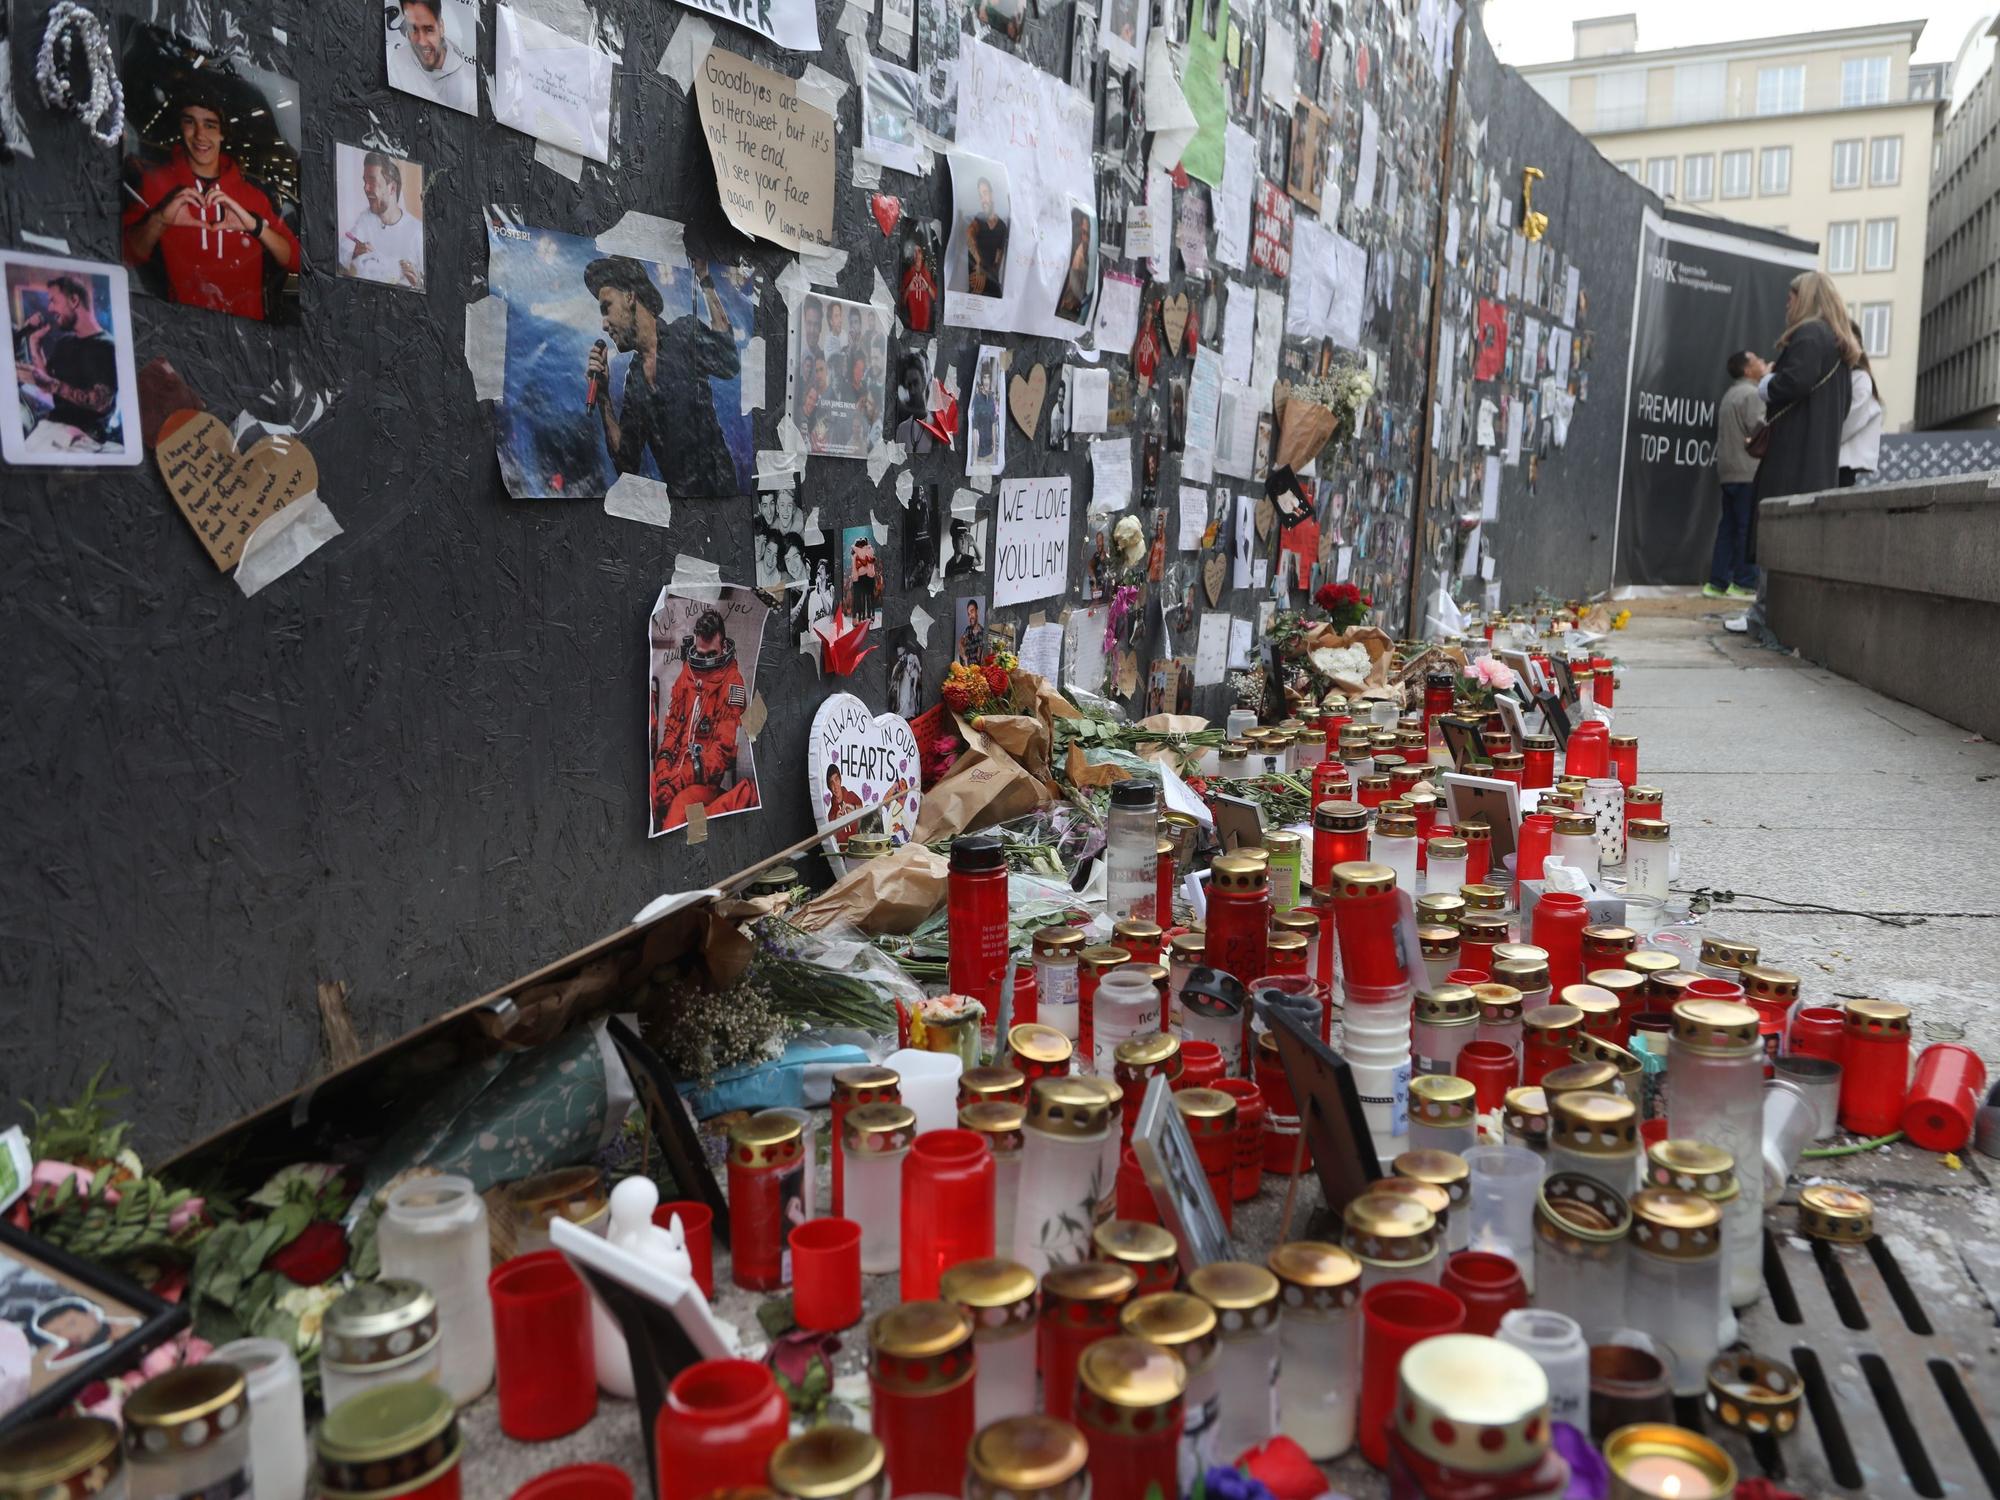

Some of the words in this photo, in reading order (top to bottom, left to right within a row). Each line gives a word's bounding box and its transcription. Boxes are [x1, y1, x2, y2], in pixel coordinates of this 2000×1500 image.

[706, 54, 772, 106] Goodbyes
[779, 92, 798, 113] are
[708, 123, 728, 145] not
[736, 130, 757, 158] the
[786, 117, 806, 142] but
[732, 164, 749, 184] see
[755, 171, 781, 199] your
[783, 176, 810, 205] face
[780, 218, 796, 237] Liam
[1638, 390, 1715, 428] PREMIUM
[1641, 433, 1670, 463] TOP
[1003, 489, 1028, 522] WE
[1035, 488, 1068, 519] LOVE
[997, 543, 1027, 582] YOU
[1032, 540, 1064, 578] LIAM
[823, 708, 868, 757] ALWAYS
[881, 725, 893, 746] IN
[896, 728, 916, 763] OUR
